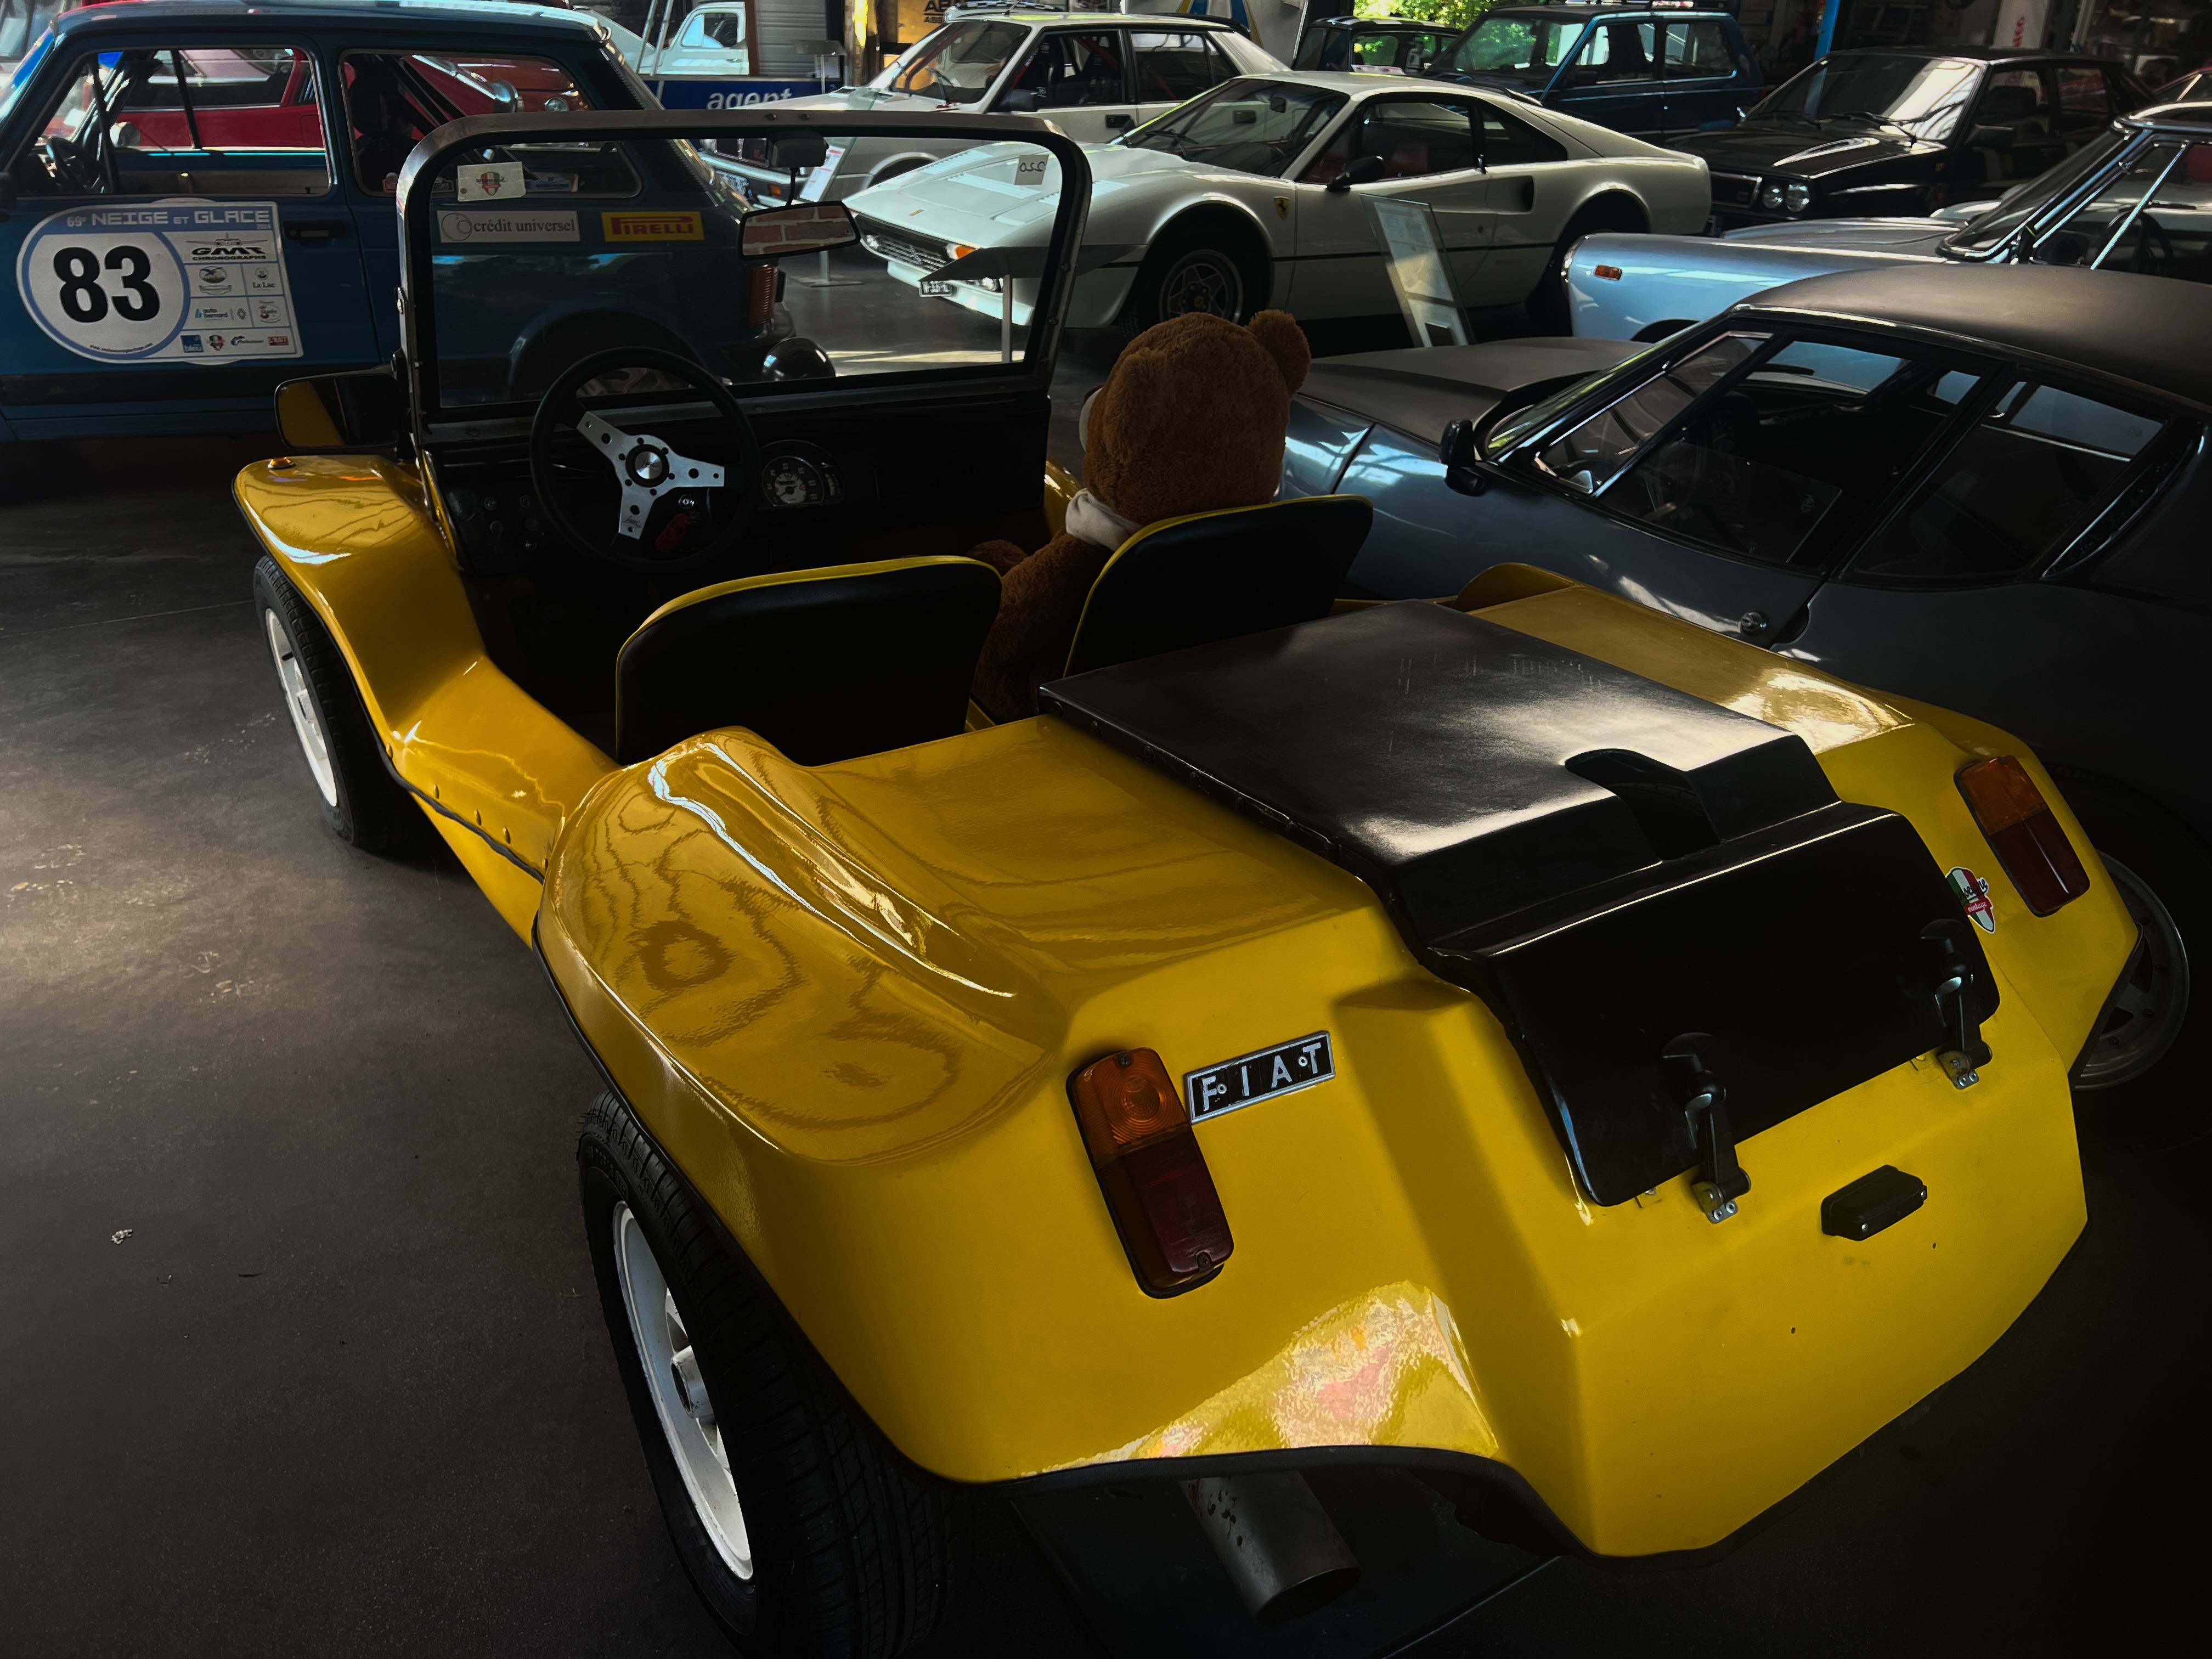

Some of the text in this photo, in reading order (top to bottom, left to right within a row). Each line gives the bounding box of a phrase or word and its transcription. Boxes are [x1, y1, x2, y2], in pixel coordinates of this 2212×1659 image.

[92, 212, 168, 225] NEIGE
[194, 210, 270, 224] GLACE
[474, 218, 575, 232] crédit universel
[611, 216, 695, 235] PIRELLI
[53, 245, 160, 323] 83
[1967, 901, 1987, 913] vintage
[1201, 1041, 1322, 1111] FIAT
